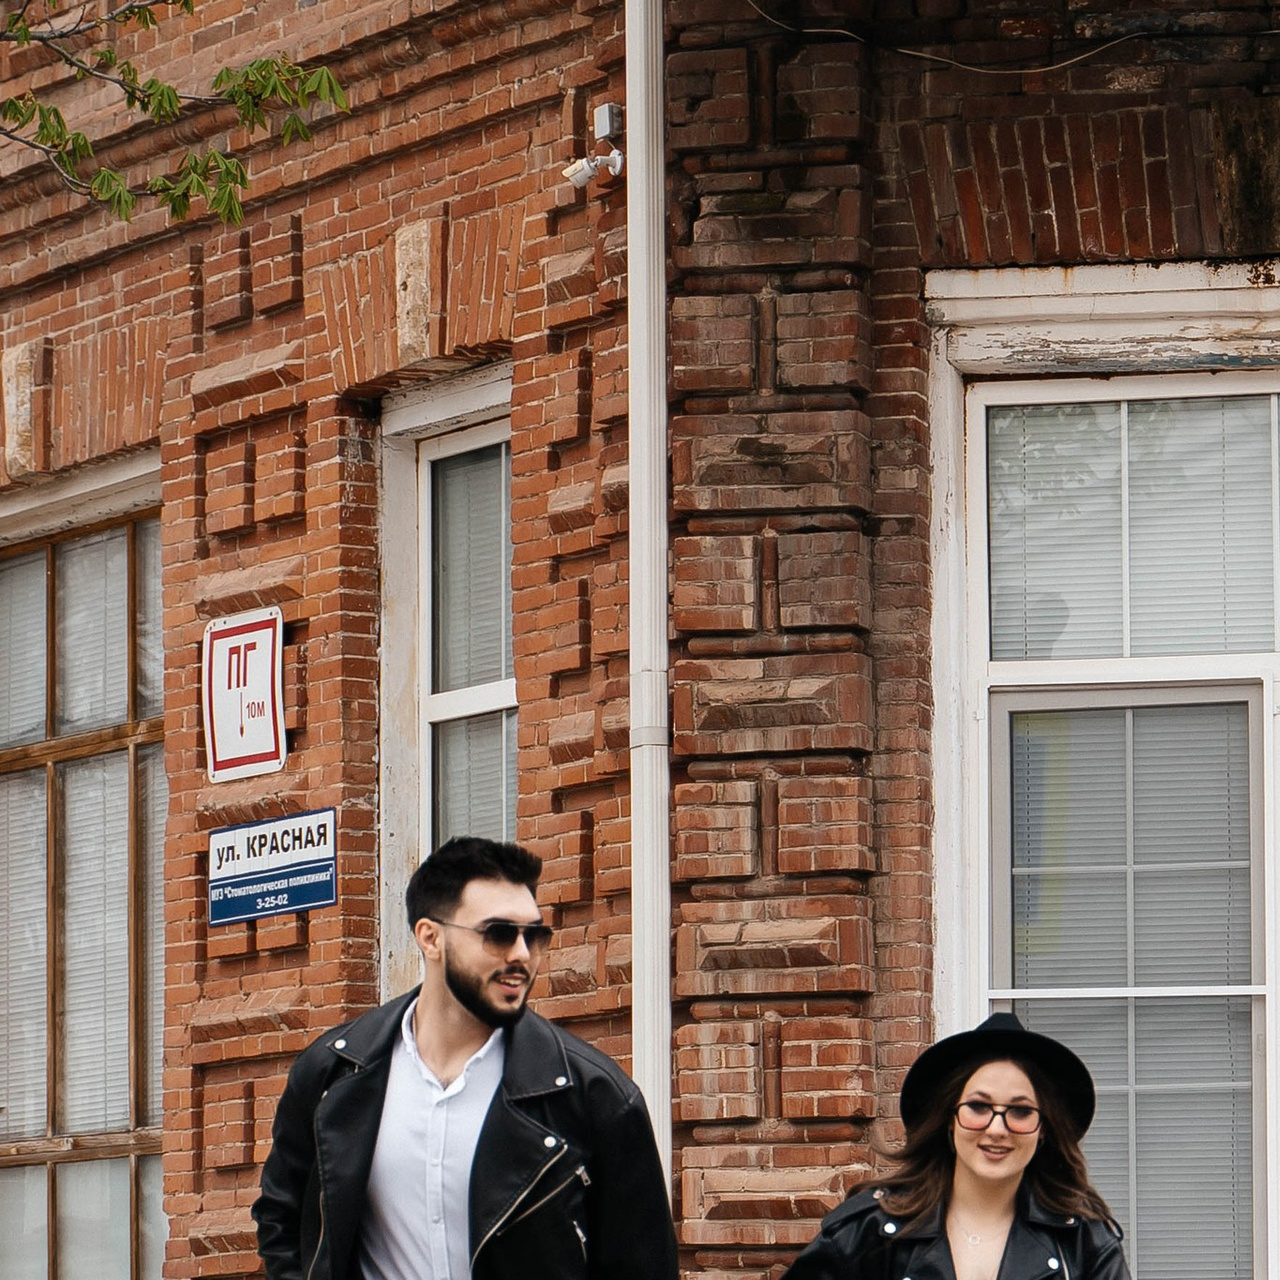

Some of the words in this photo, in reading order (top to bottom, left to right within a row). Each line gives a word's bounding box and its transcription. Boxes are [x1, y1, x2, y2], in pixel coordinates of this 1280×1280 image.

[227, 641, 257, 690] ПГ
[216, 845, 241, 870] ул.
[246, 823, 328, 858] КРАСНАЯ
[256, 893, 289, 909] 3-25-02
